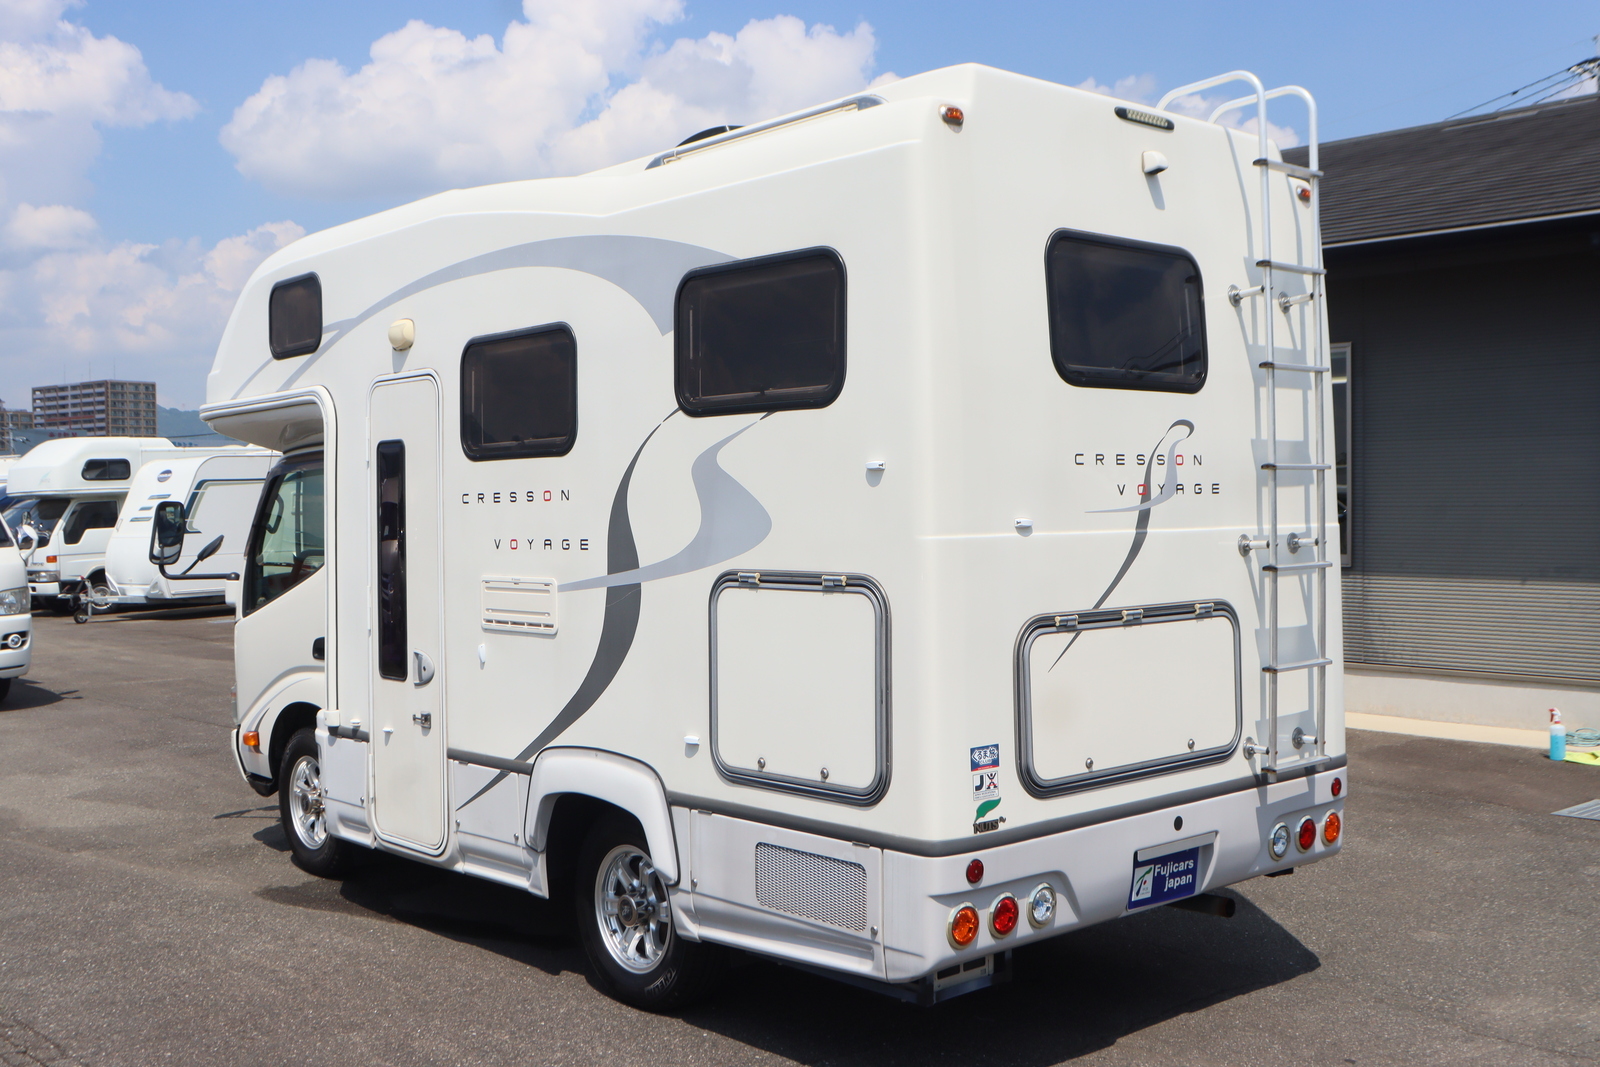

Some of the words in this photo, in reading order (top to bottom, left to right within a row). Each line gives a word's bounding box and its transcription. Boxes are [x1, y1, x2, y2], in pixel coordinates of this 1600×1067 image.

[1074, 453, 1203, 466] CRESSON
[461, 489, 570, 505] CRESSON
[1117, 483, 1220, 496] VOYAGE
[494, 538, 589, 551] VOYAGE
[973, 819, 999, 834] NUTS
[1154, 859, 1194, 877] Fujicars
[1164, 874, 1192, 892] japan
